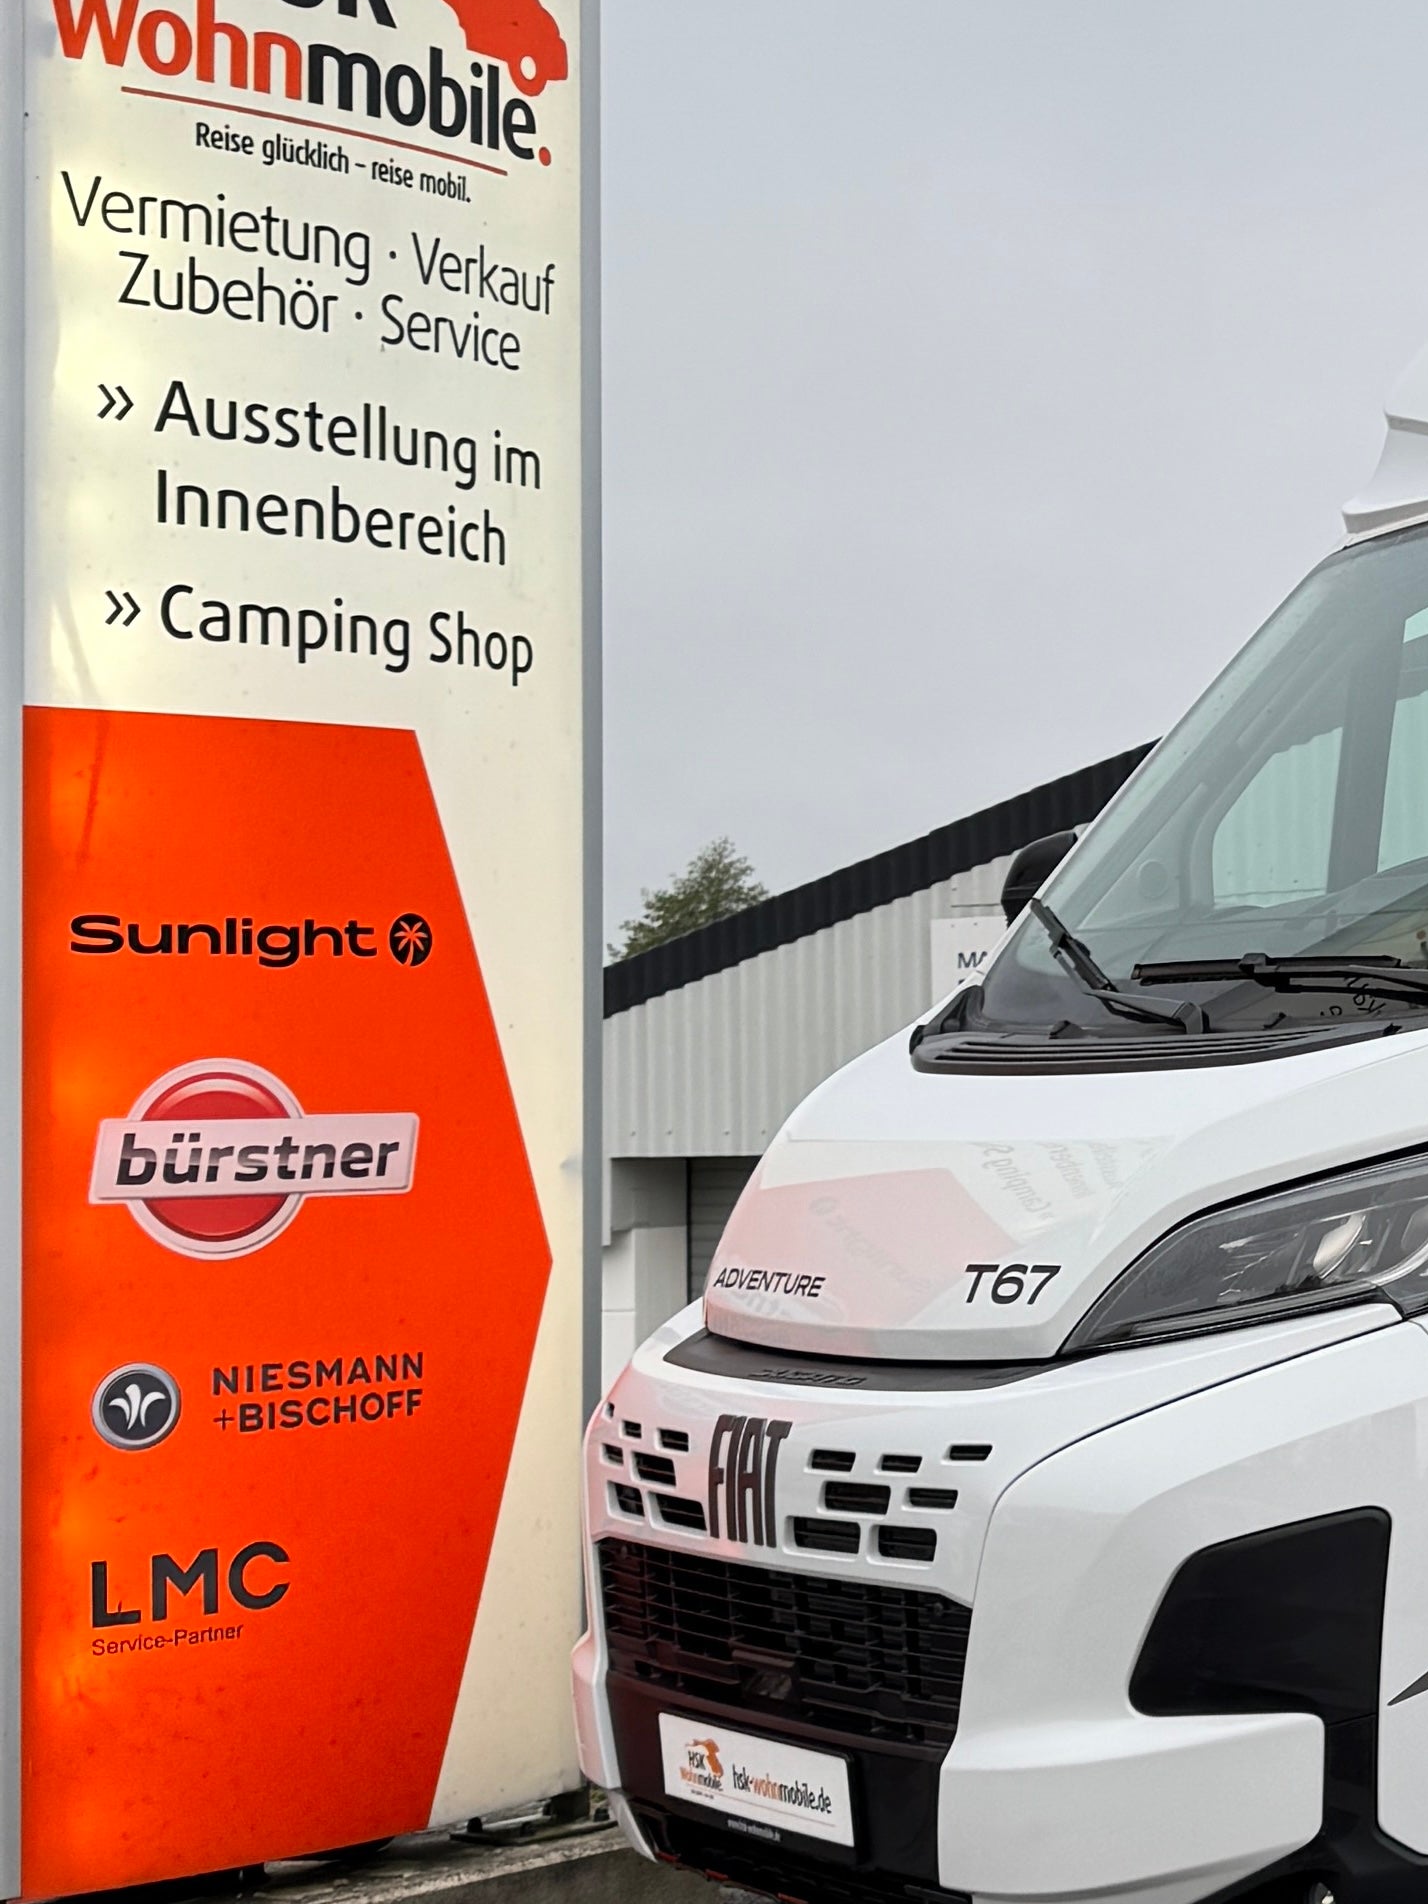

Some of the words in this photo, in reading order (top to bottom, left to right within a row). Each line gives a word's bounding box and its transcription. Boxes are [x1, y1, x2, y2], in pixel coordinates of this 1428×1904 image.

[195, 121, 254, 155] Reise
[262, 131, 350, 174] glücklich
[371, 156, 413, 189] reise
[420, 165, 471, 202] mobil.
[60, 170, 371, 286] Vermietung
[411, 231, 556, 315] Verkauf
[118, 250, 339, 333] Zubehör
[380, 294, 521, 371] Service
[153, 380, 477, 491] Ausstellung
[492, 429, 541, 489] im
[156, 469, 506, 566] Innenbereich
[160, 584, 410, 673] Camping
[429, 611, 534, 687] Shop
[69, 914, 378, 968] Sunlight
[115, 1132, 400, 1186] bürstner
[713, 1266, 827, 1299] ADVENTURE
[963, 1263, 1062, 1306] T67
[212, 1350, 424, 1396] NIESMANN
[212, 1388, 424, 1433] +BISCHOFF
[708, 1413, 794, 1549] FIAT
[91, 1540, 291, 1628] LMC
[91, 1622, 244, 1657] Service-Partner
[687, 1750, 706, 1771] HSK
[732, 1763, 833, 1815] hsk-wohnmobile.de
